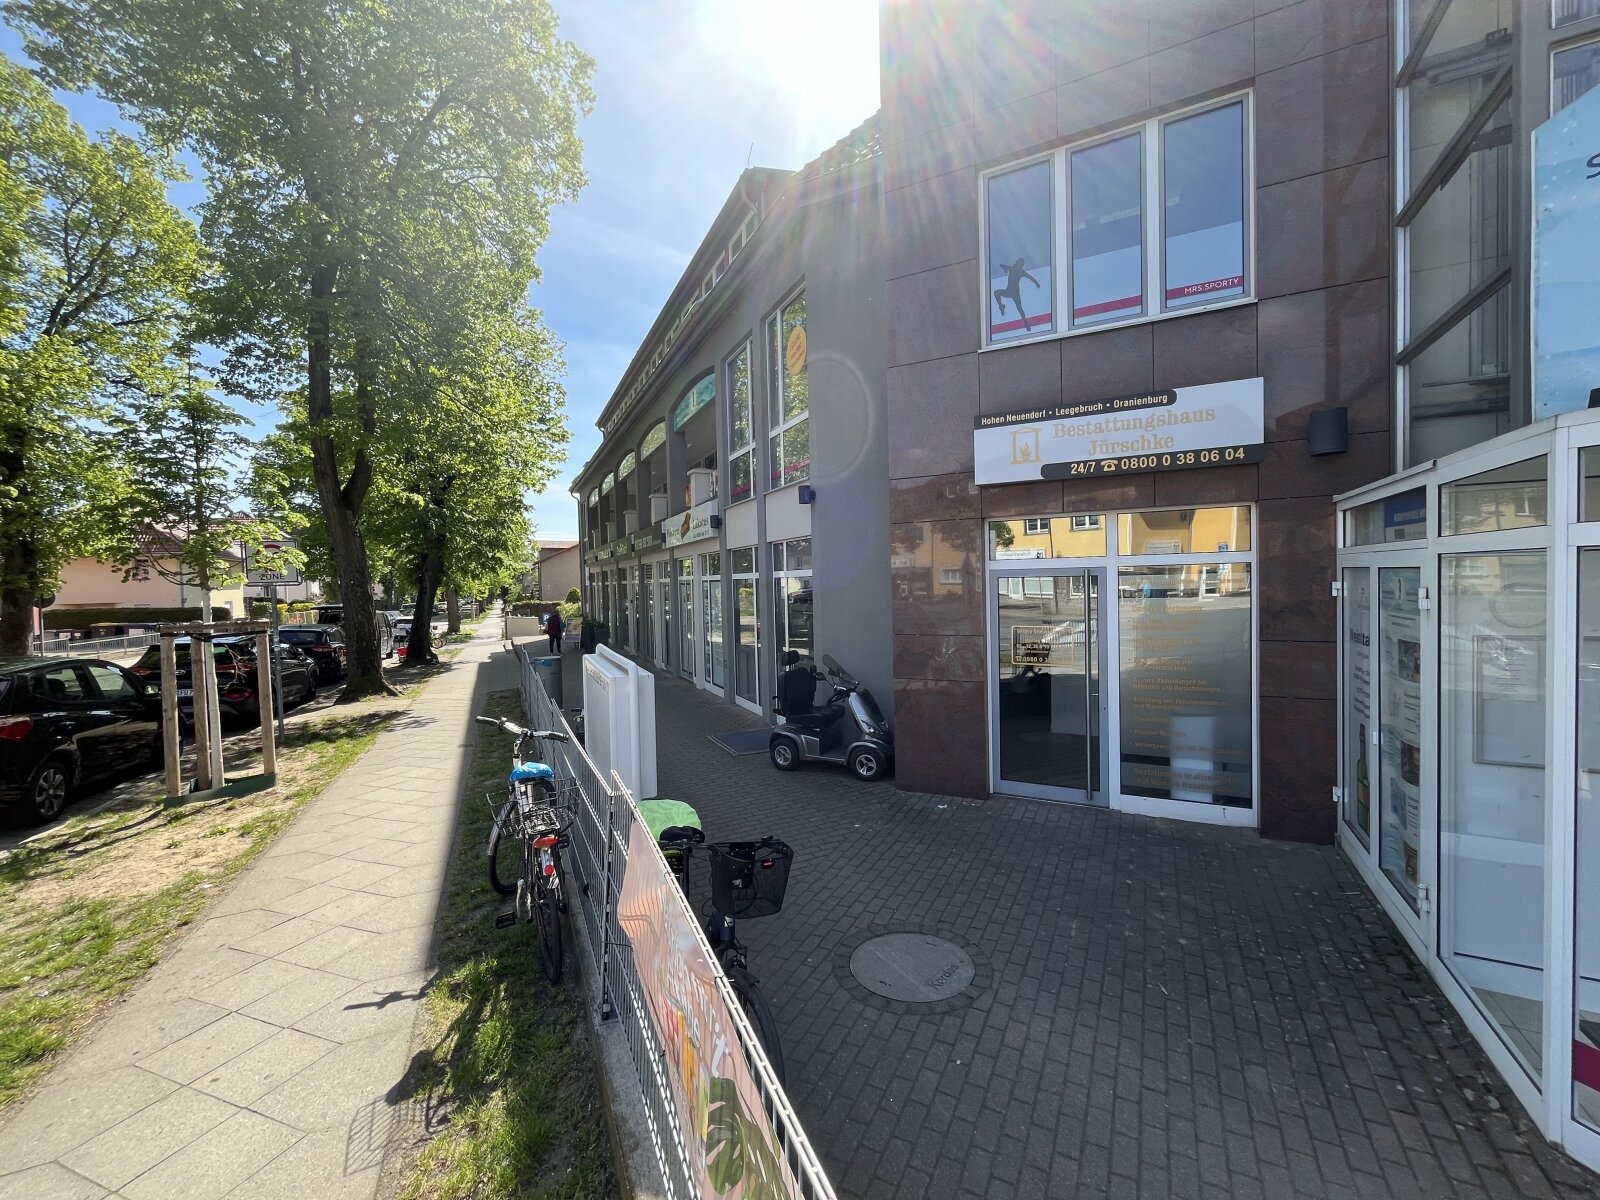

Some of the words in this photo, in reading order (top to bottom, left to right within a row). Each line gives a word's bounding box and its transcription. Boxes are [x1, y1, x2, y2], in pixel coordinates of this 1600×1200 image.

[1184, 278, 1239, 294] MRS.SPORTY
[981, 416, 1005, 426] Hohen
[1006, 409, 1046, 423] Neuendorf
[1055, 402, 1103, 416] Leegebruch
[1113, 394, 1168, 408] Oranienburg
[1053, 408, 1217, 439] Bestattungshaus
[1088, 434, 1174, 456] Jürschke
[1070, 461, 1096, 475] 24/7
[1121, 455, 1157, 470] 0800
[1162, 454, 1171, 466] 0
[1176, 452, 1195, 465] 38
[1200, 450, 1220, 462] 06
[1225, 447, 1245, 460] 04
[260, 572, 285, 581] ZONE
